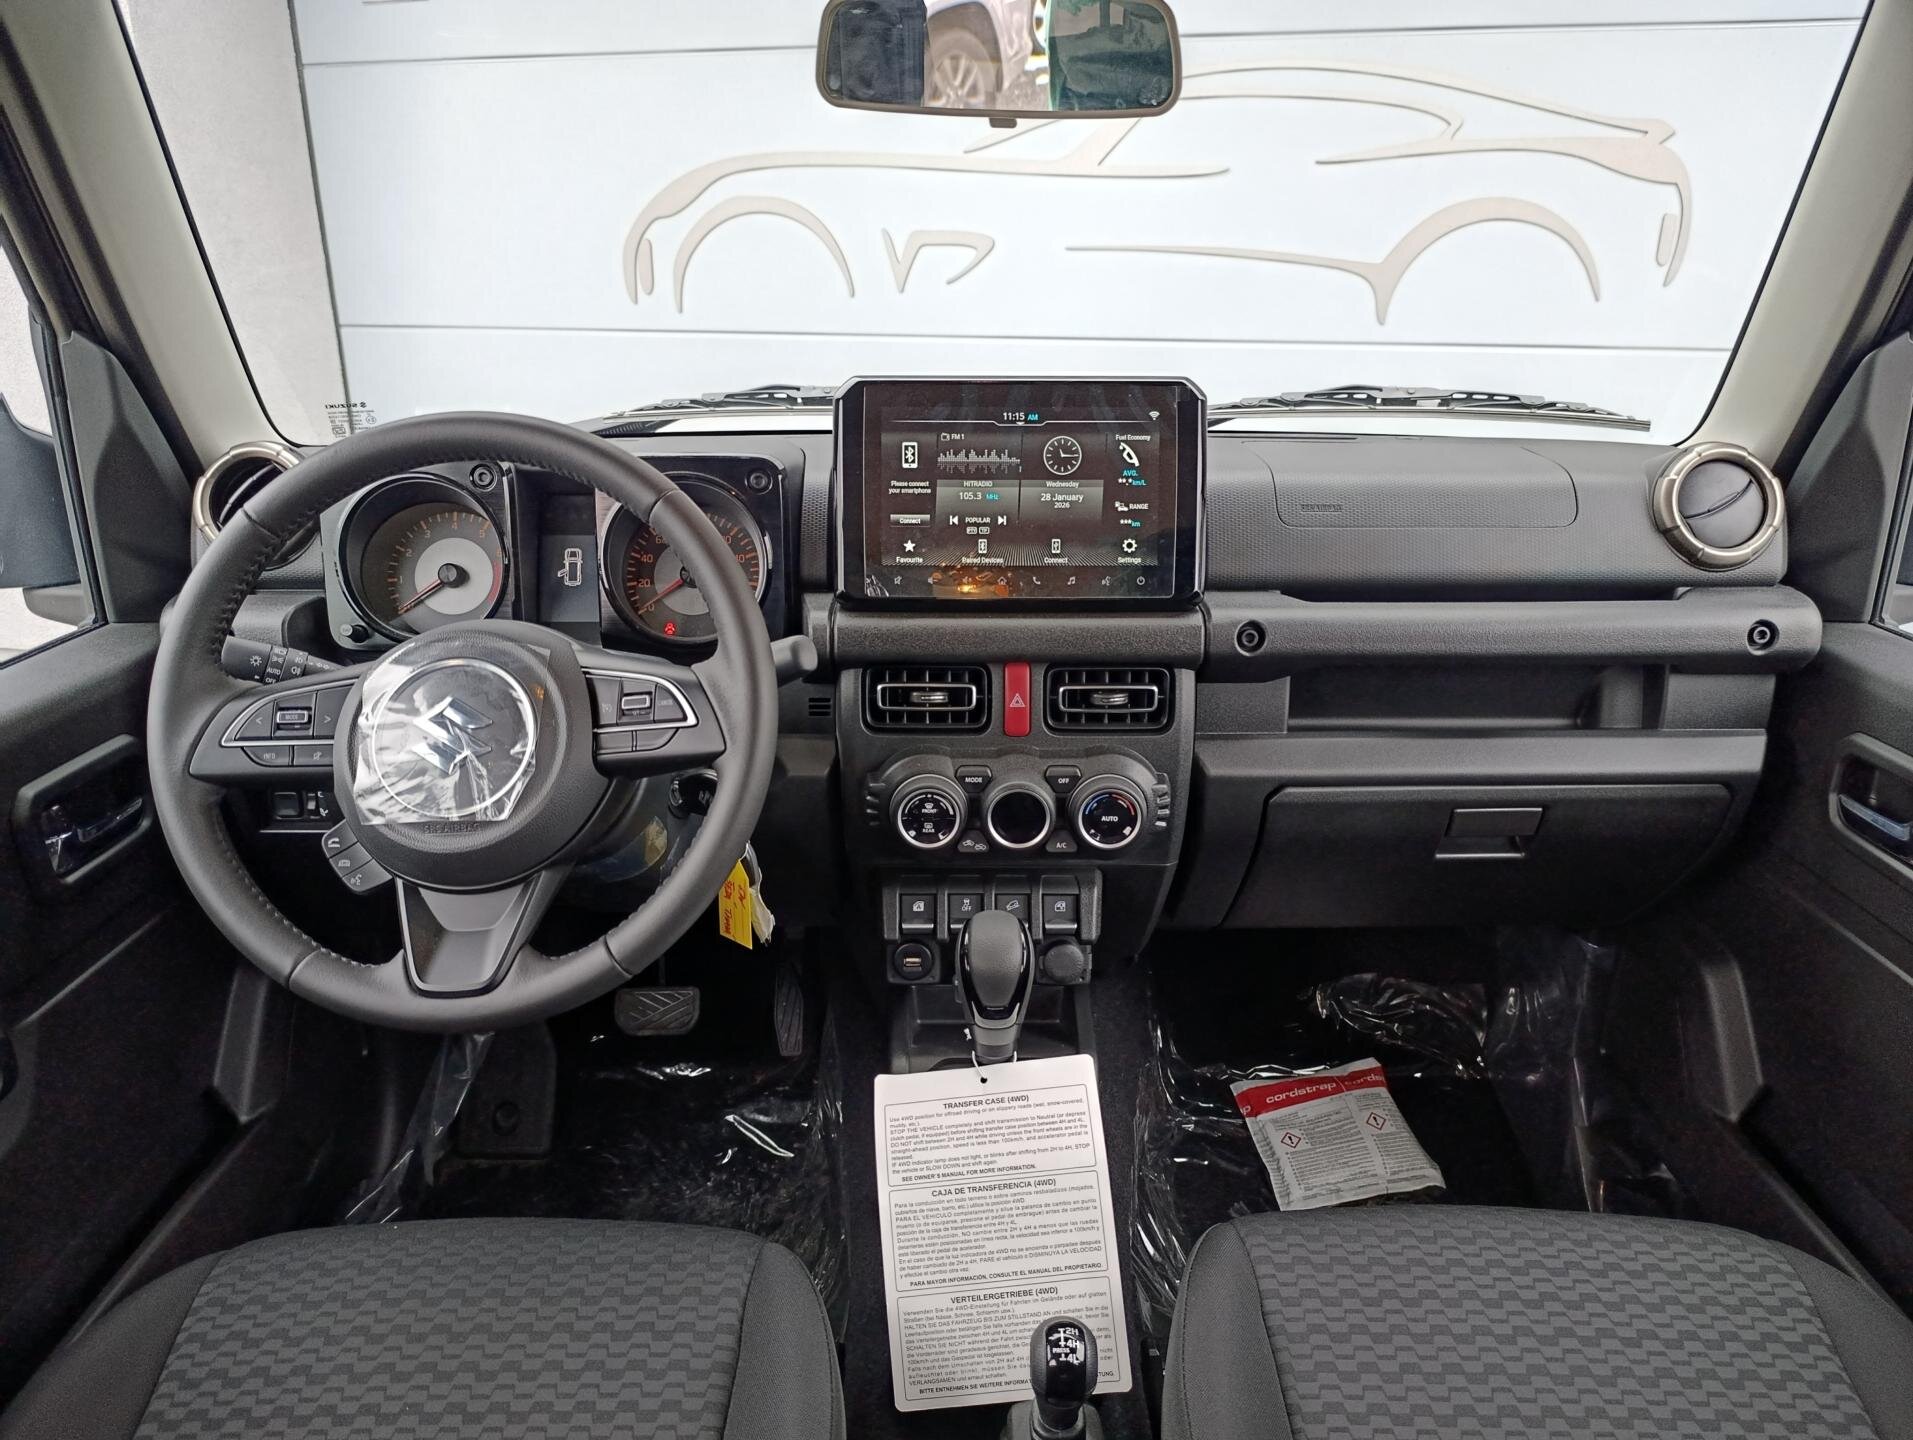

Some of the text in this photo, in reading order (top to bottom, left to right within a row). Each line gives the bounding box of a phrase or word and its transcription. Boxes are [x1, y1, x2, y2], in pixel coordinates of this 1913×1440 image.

[1003, 412, 1025, 420] 11:15
[1053, 493, 1083, 502] January
[1266, 1082, 1336, 1104] cordstrap
[943, 1099, 983, 1108] TRANSFER
[1007, 1095, 1029, 1103] (4WD)
[931, 1188, 952, 1197] CAJA
[967, 1181, 1031, 1192] TRANSFERENCIA
[1033, 1178, 1056, 1187] (4WD)
[988, 1270, 1018, 1278] CONSULTE
[951, 1286, 1058, 1303] VERTEILERGETRIEBE (4WD)
[1066, 1327, 1078, 1335] 2H
[1067, 1339, 1079, 1348] 4H
[1067, 1354, 1080, 1364] 4L
